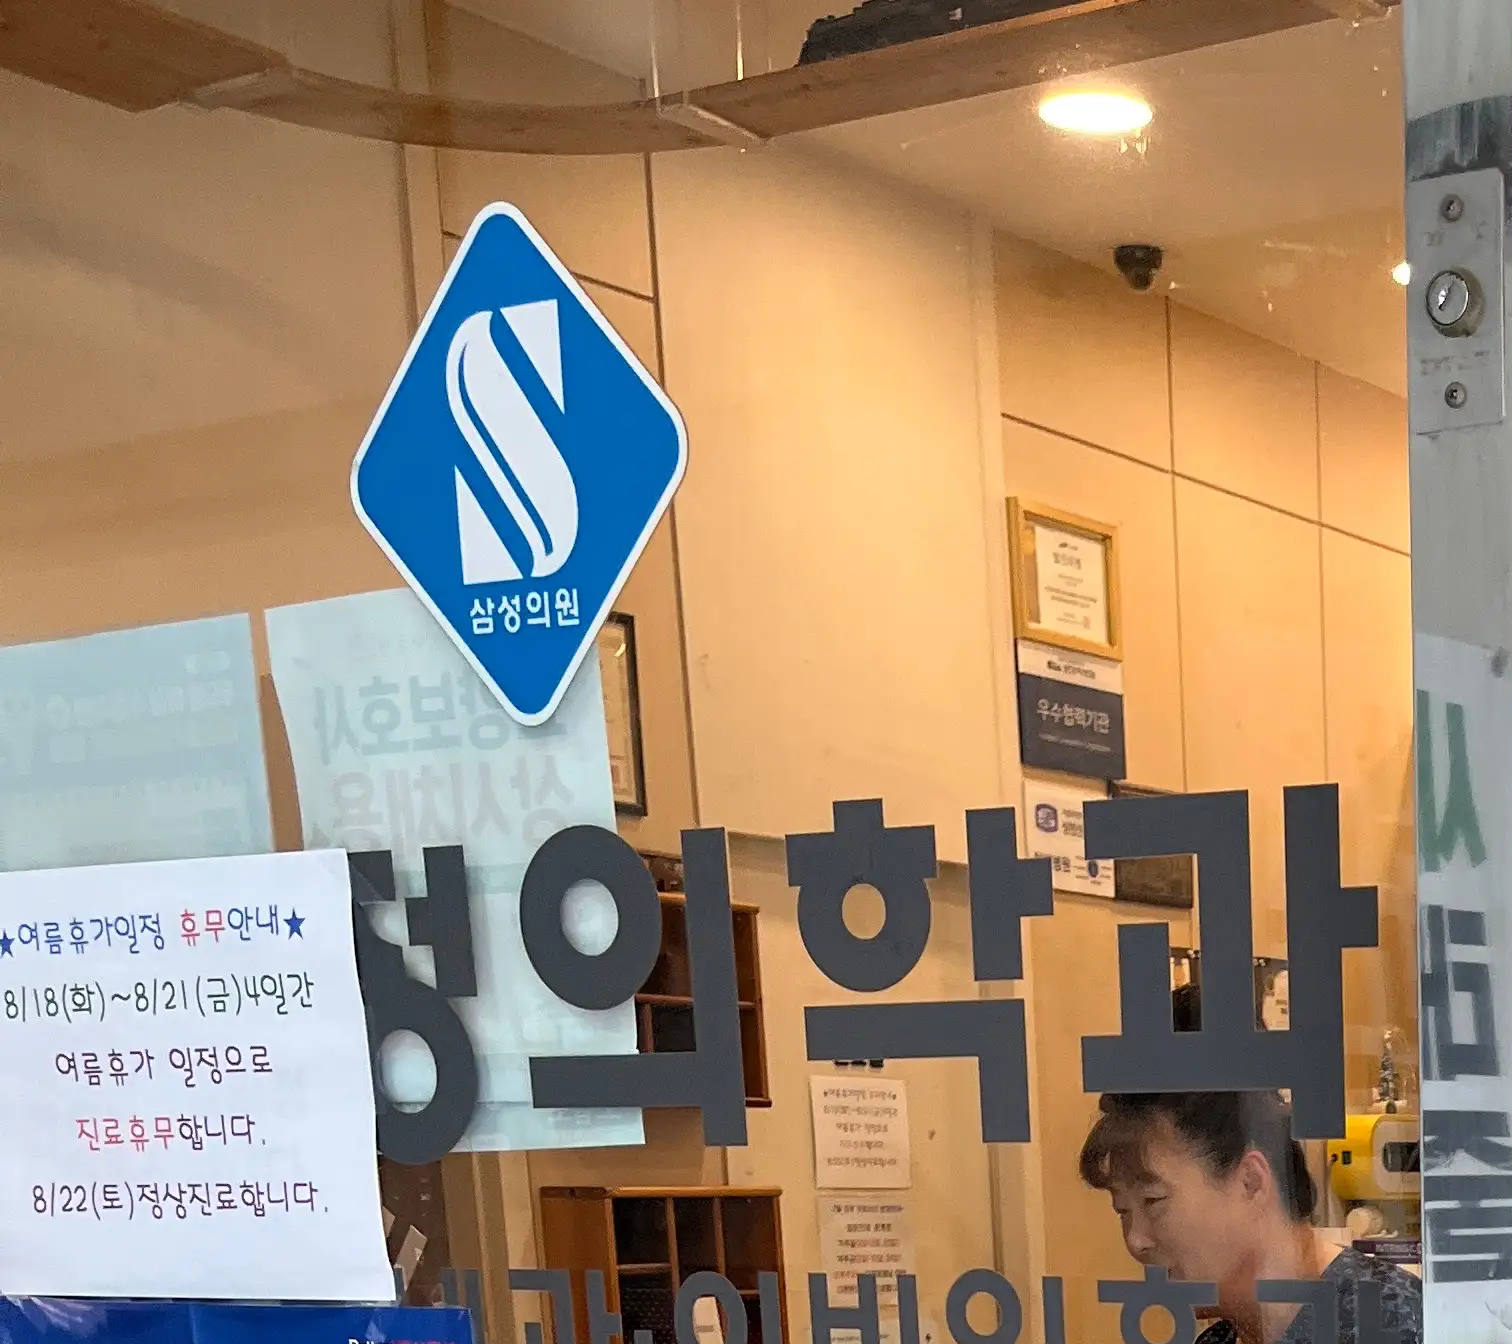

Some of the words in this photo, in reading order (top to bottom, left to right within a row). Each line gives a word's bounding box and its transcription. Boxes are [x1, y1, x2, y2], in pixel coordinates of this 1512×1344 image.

[470, 587, 581, 635] 삼성의원
[18, 911, 166, 955] 여름휴가일정
[180, 904, 281, 943] 휴무안내
[349, 783, 1378, 1165] 정의학과
[55, 1048, 155, 1087] 여름휴가
[168, 1044, 273, 1087] 일정으로
[76, 1114, 267, 1152] 진료휴무합니다.
